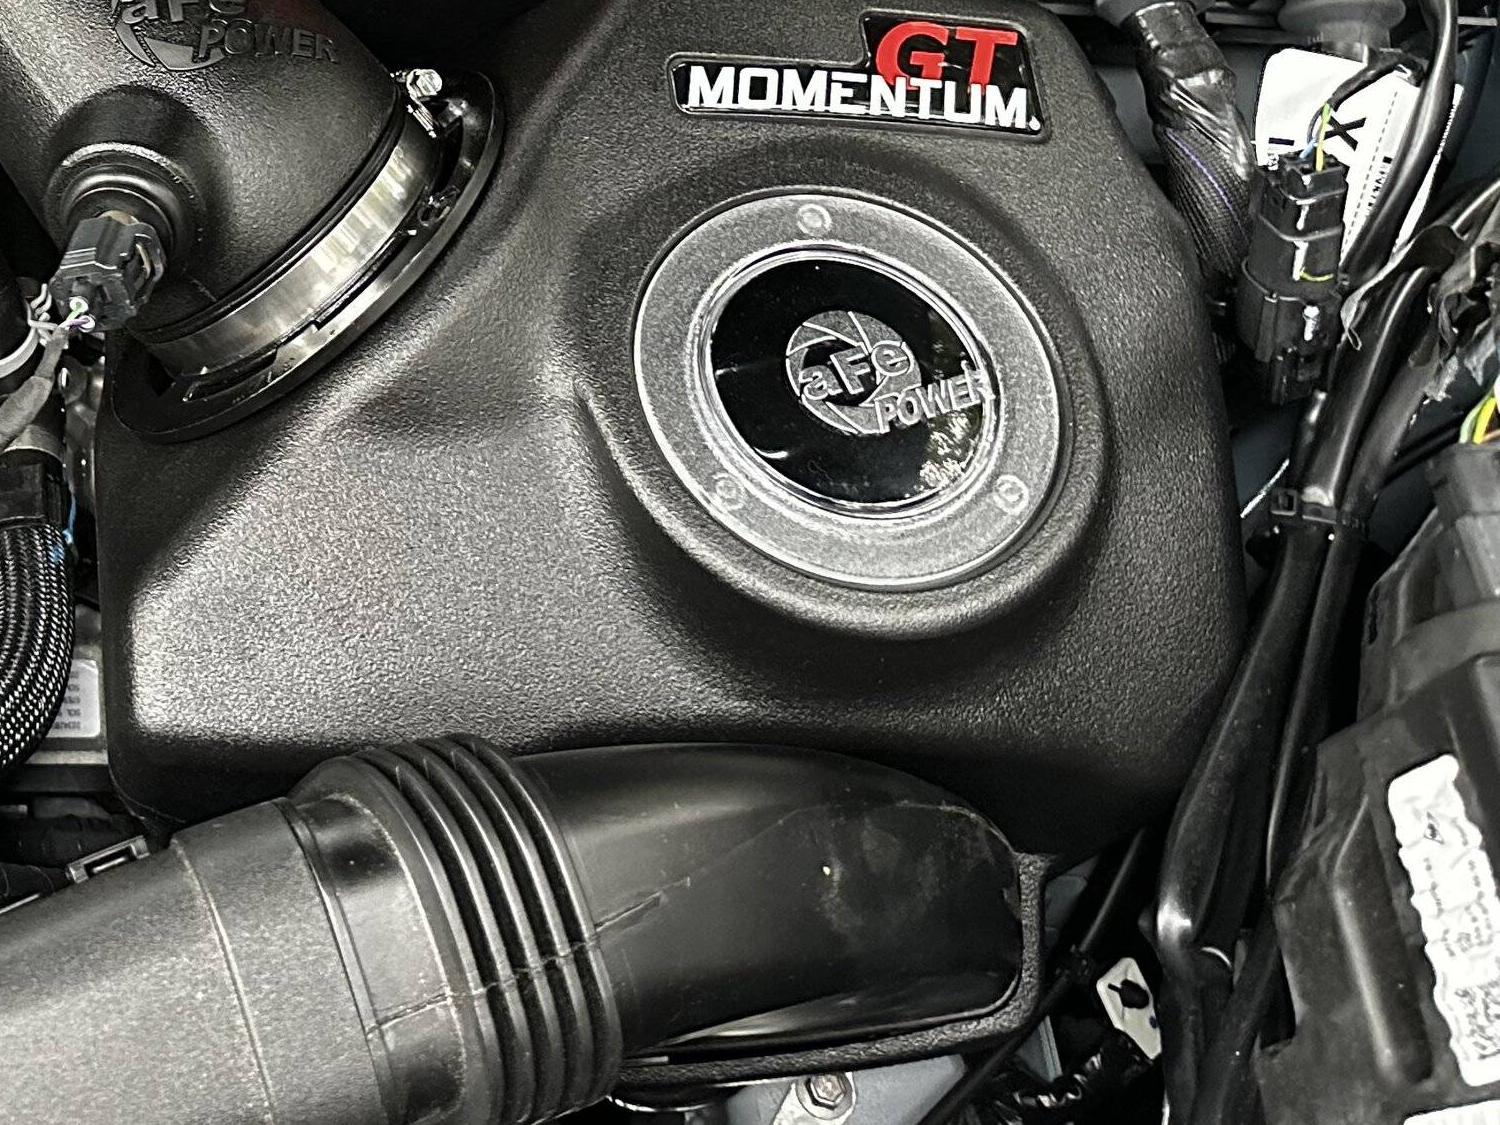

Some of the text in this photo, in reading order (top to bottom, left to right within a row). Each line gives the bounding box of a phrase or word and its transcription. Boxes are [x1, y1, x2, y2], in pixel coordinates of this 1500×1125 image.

[197, 17, 339, 64] POWER
[875, 20, 1018, 89] GT
[798, 340, 912, 400] aFe
